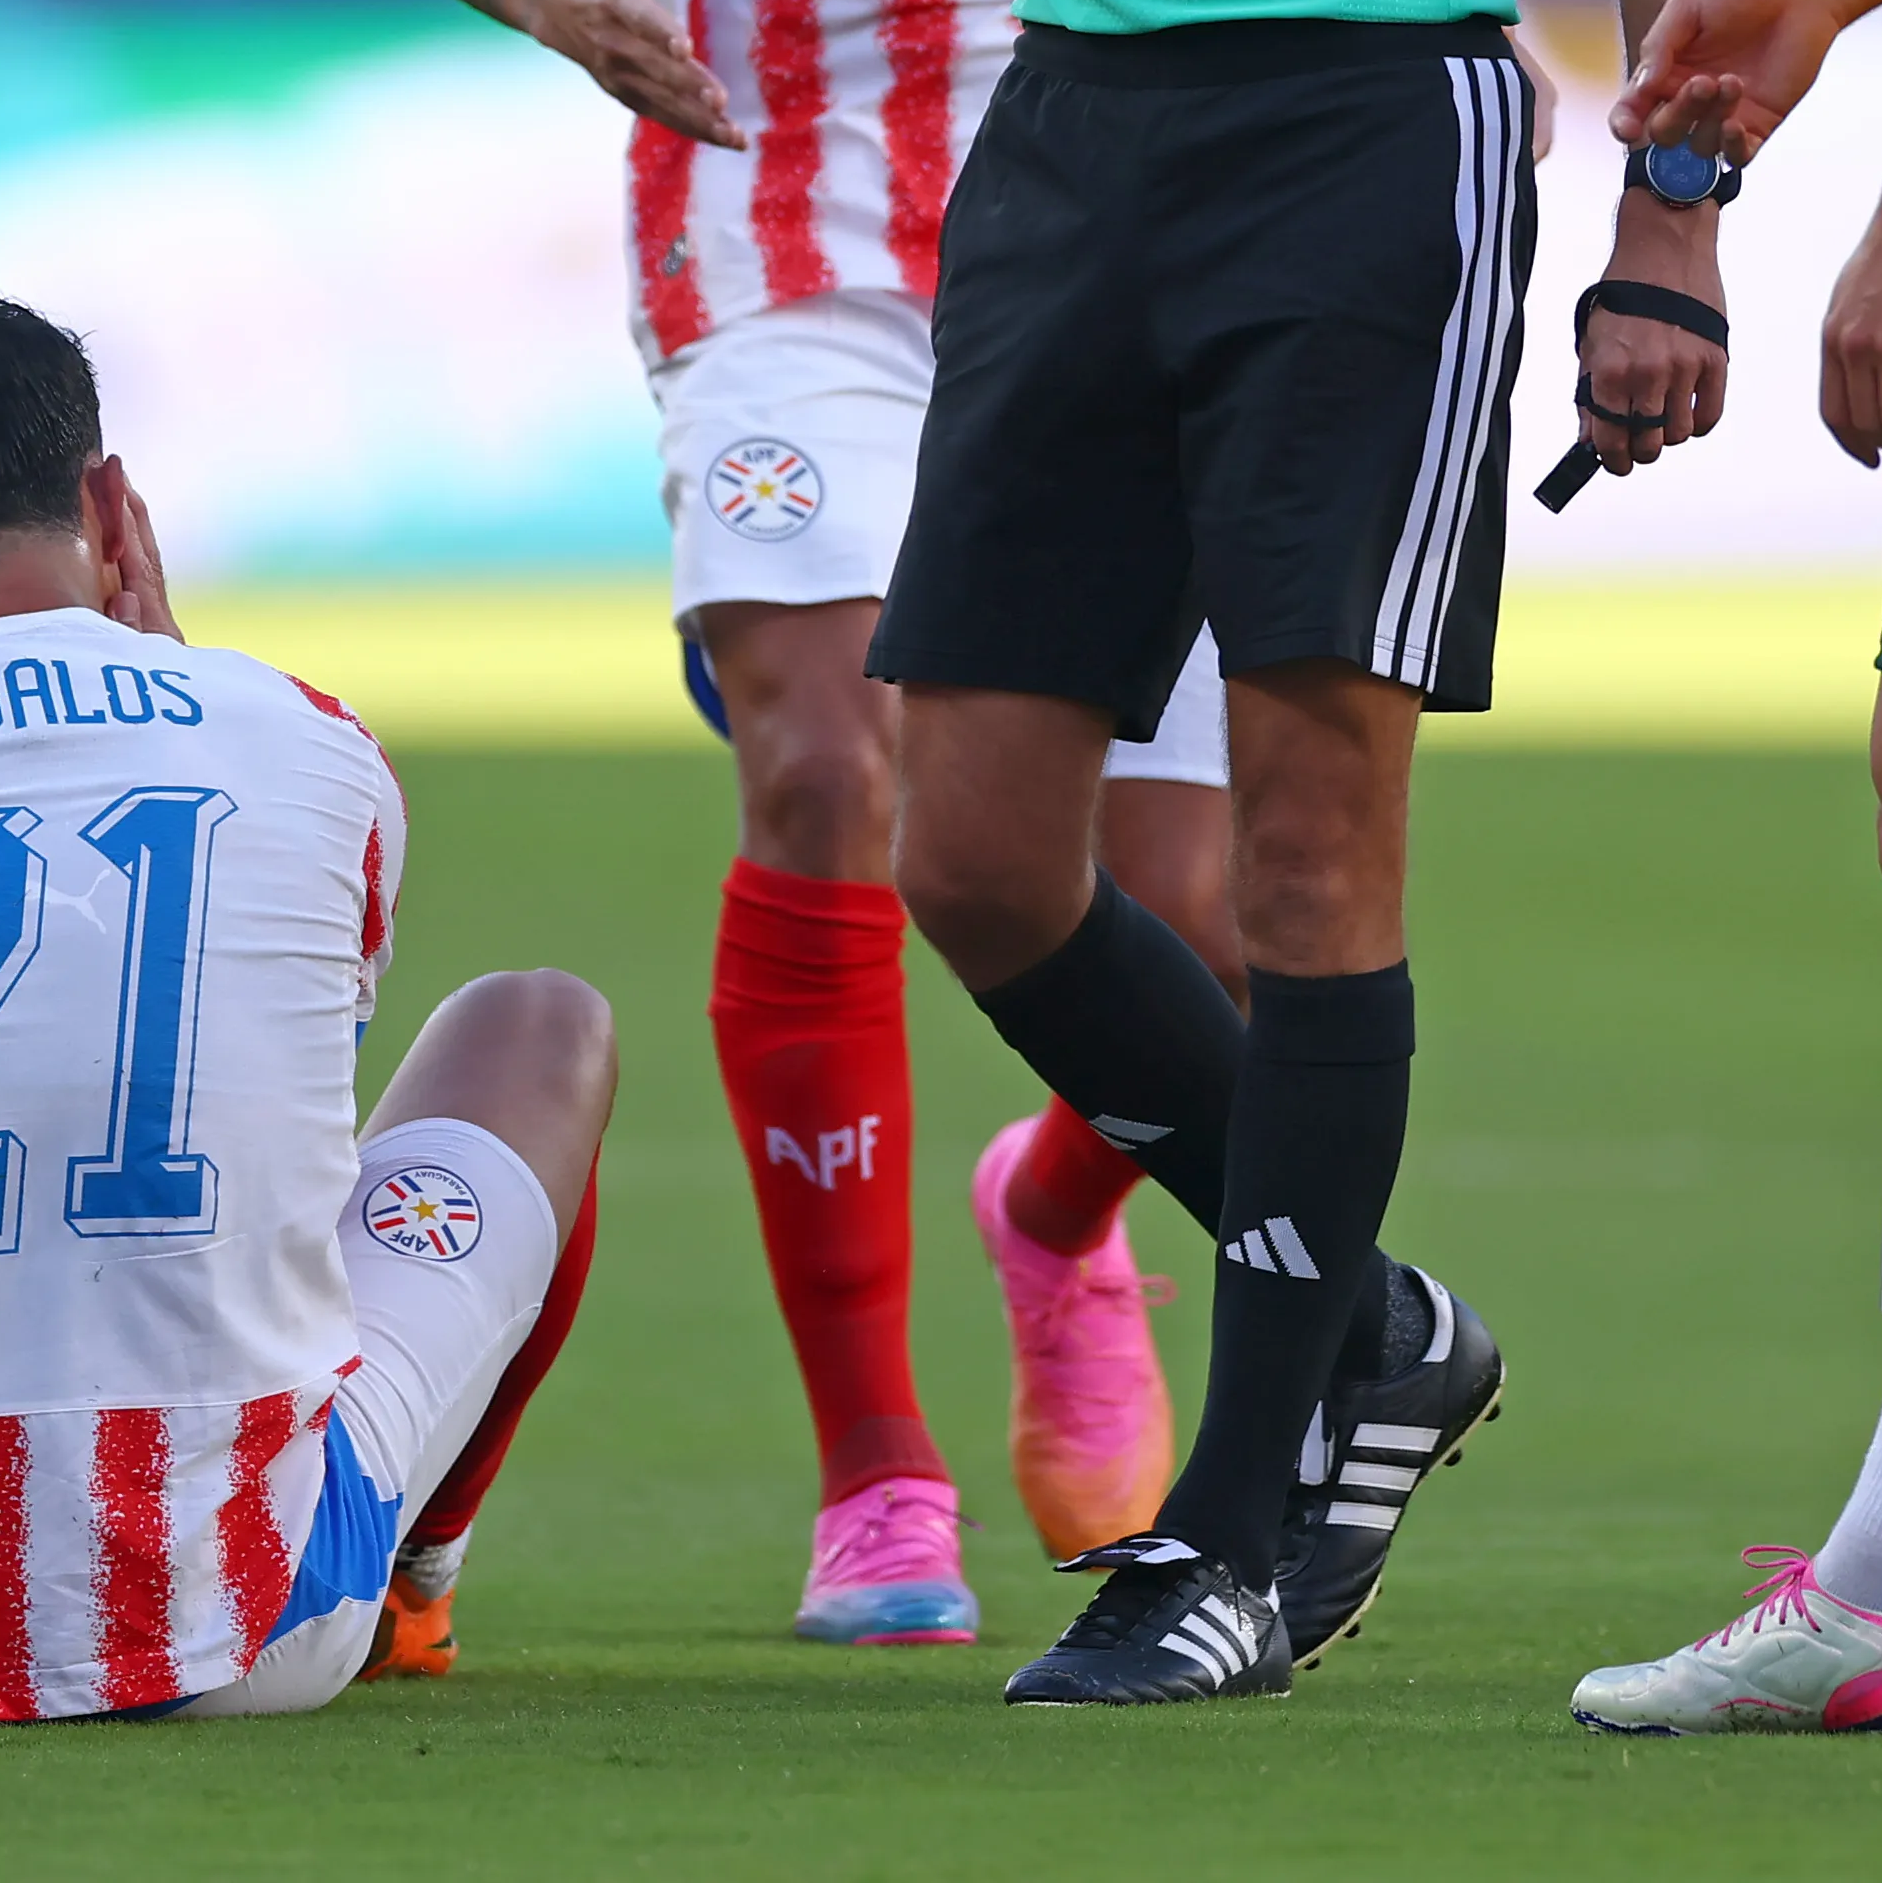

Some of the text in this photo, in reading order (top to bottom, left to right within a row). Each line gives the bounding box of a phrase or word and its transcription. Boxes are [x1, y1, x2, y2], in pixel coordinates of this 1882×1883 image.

[764, 1112, 882, 1191] APF
[415, 1171, 467, 1196] PARAGUAY
[388, 1230, 431, 1253] APF
